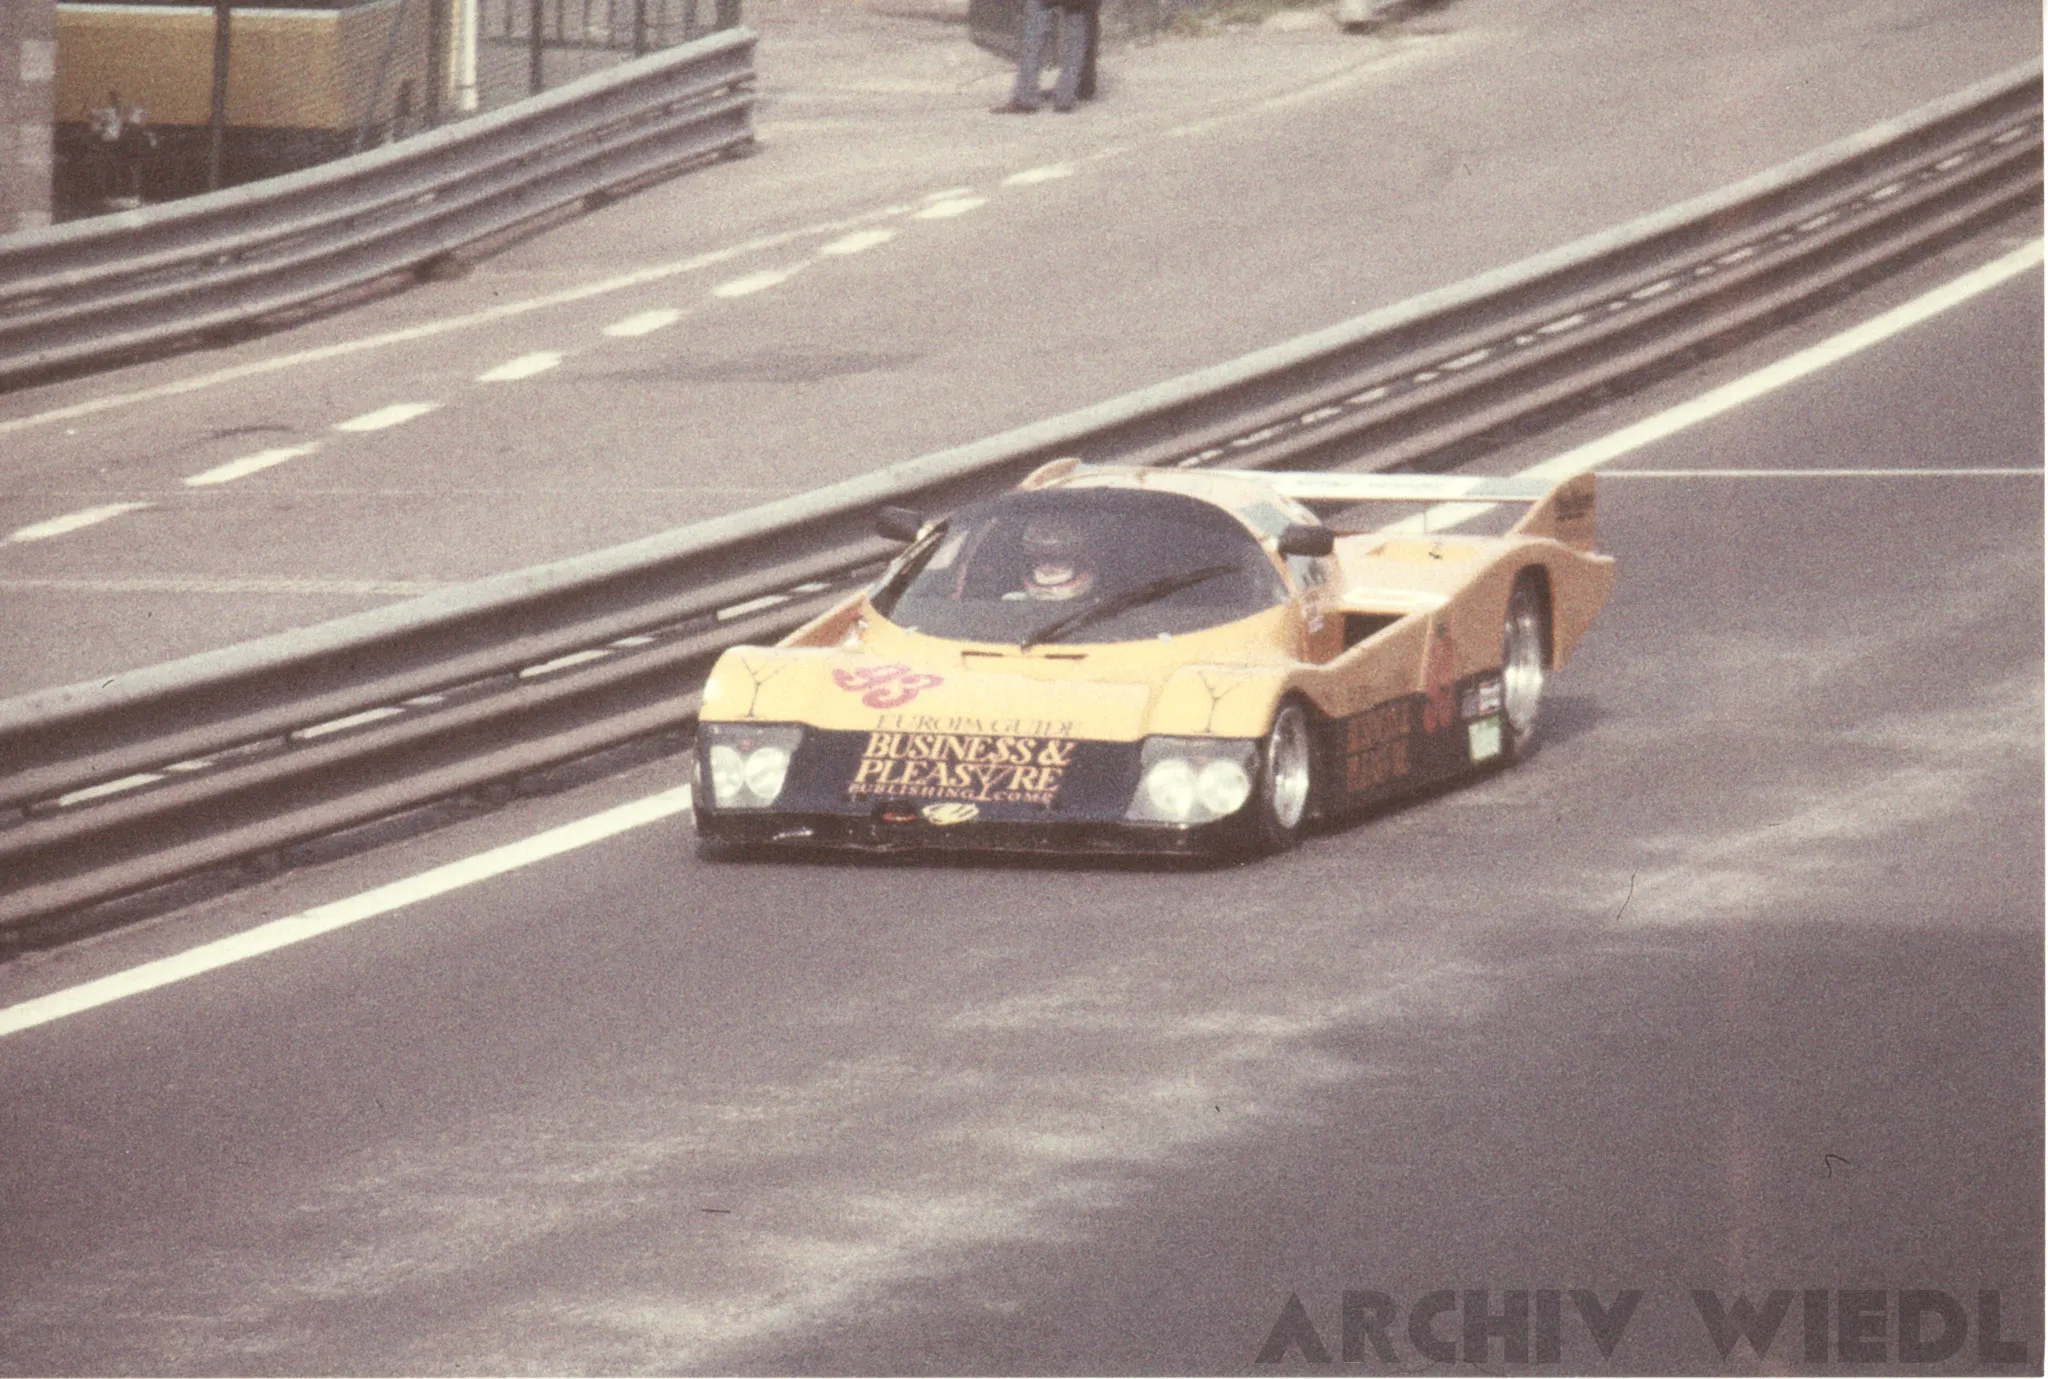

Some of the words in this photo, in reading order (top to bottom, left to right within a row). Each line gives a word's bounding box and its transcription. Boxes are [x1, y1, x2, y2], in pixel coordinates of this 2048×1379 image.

[862, 731, 1036, 766] BUSINESS
[1037, 738, 1079, 767] &
[848, 782, 978, 800] PUBLISHING
